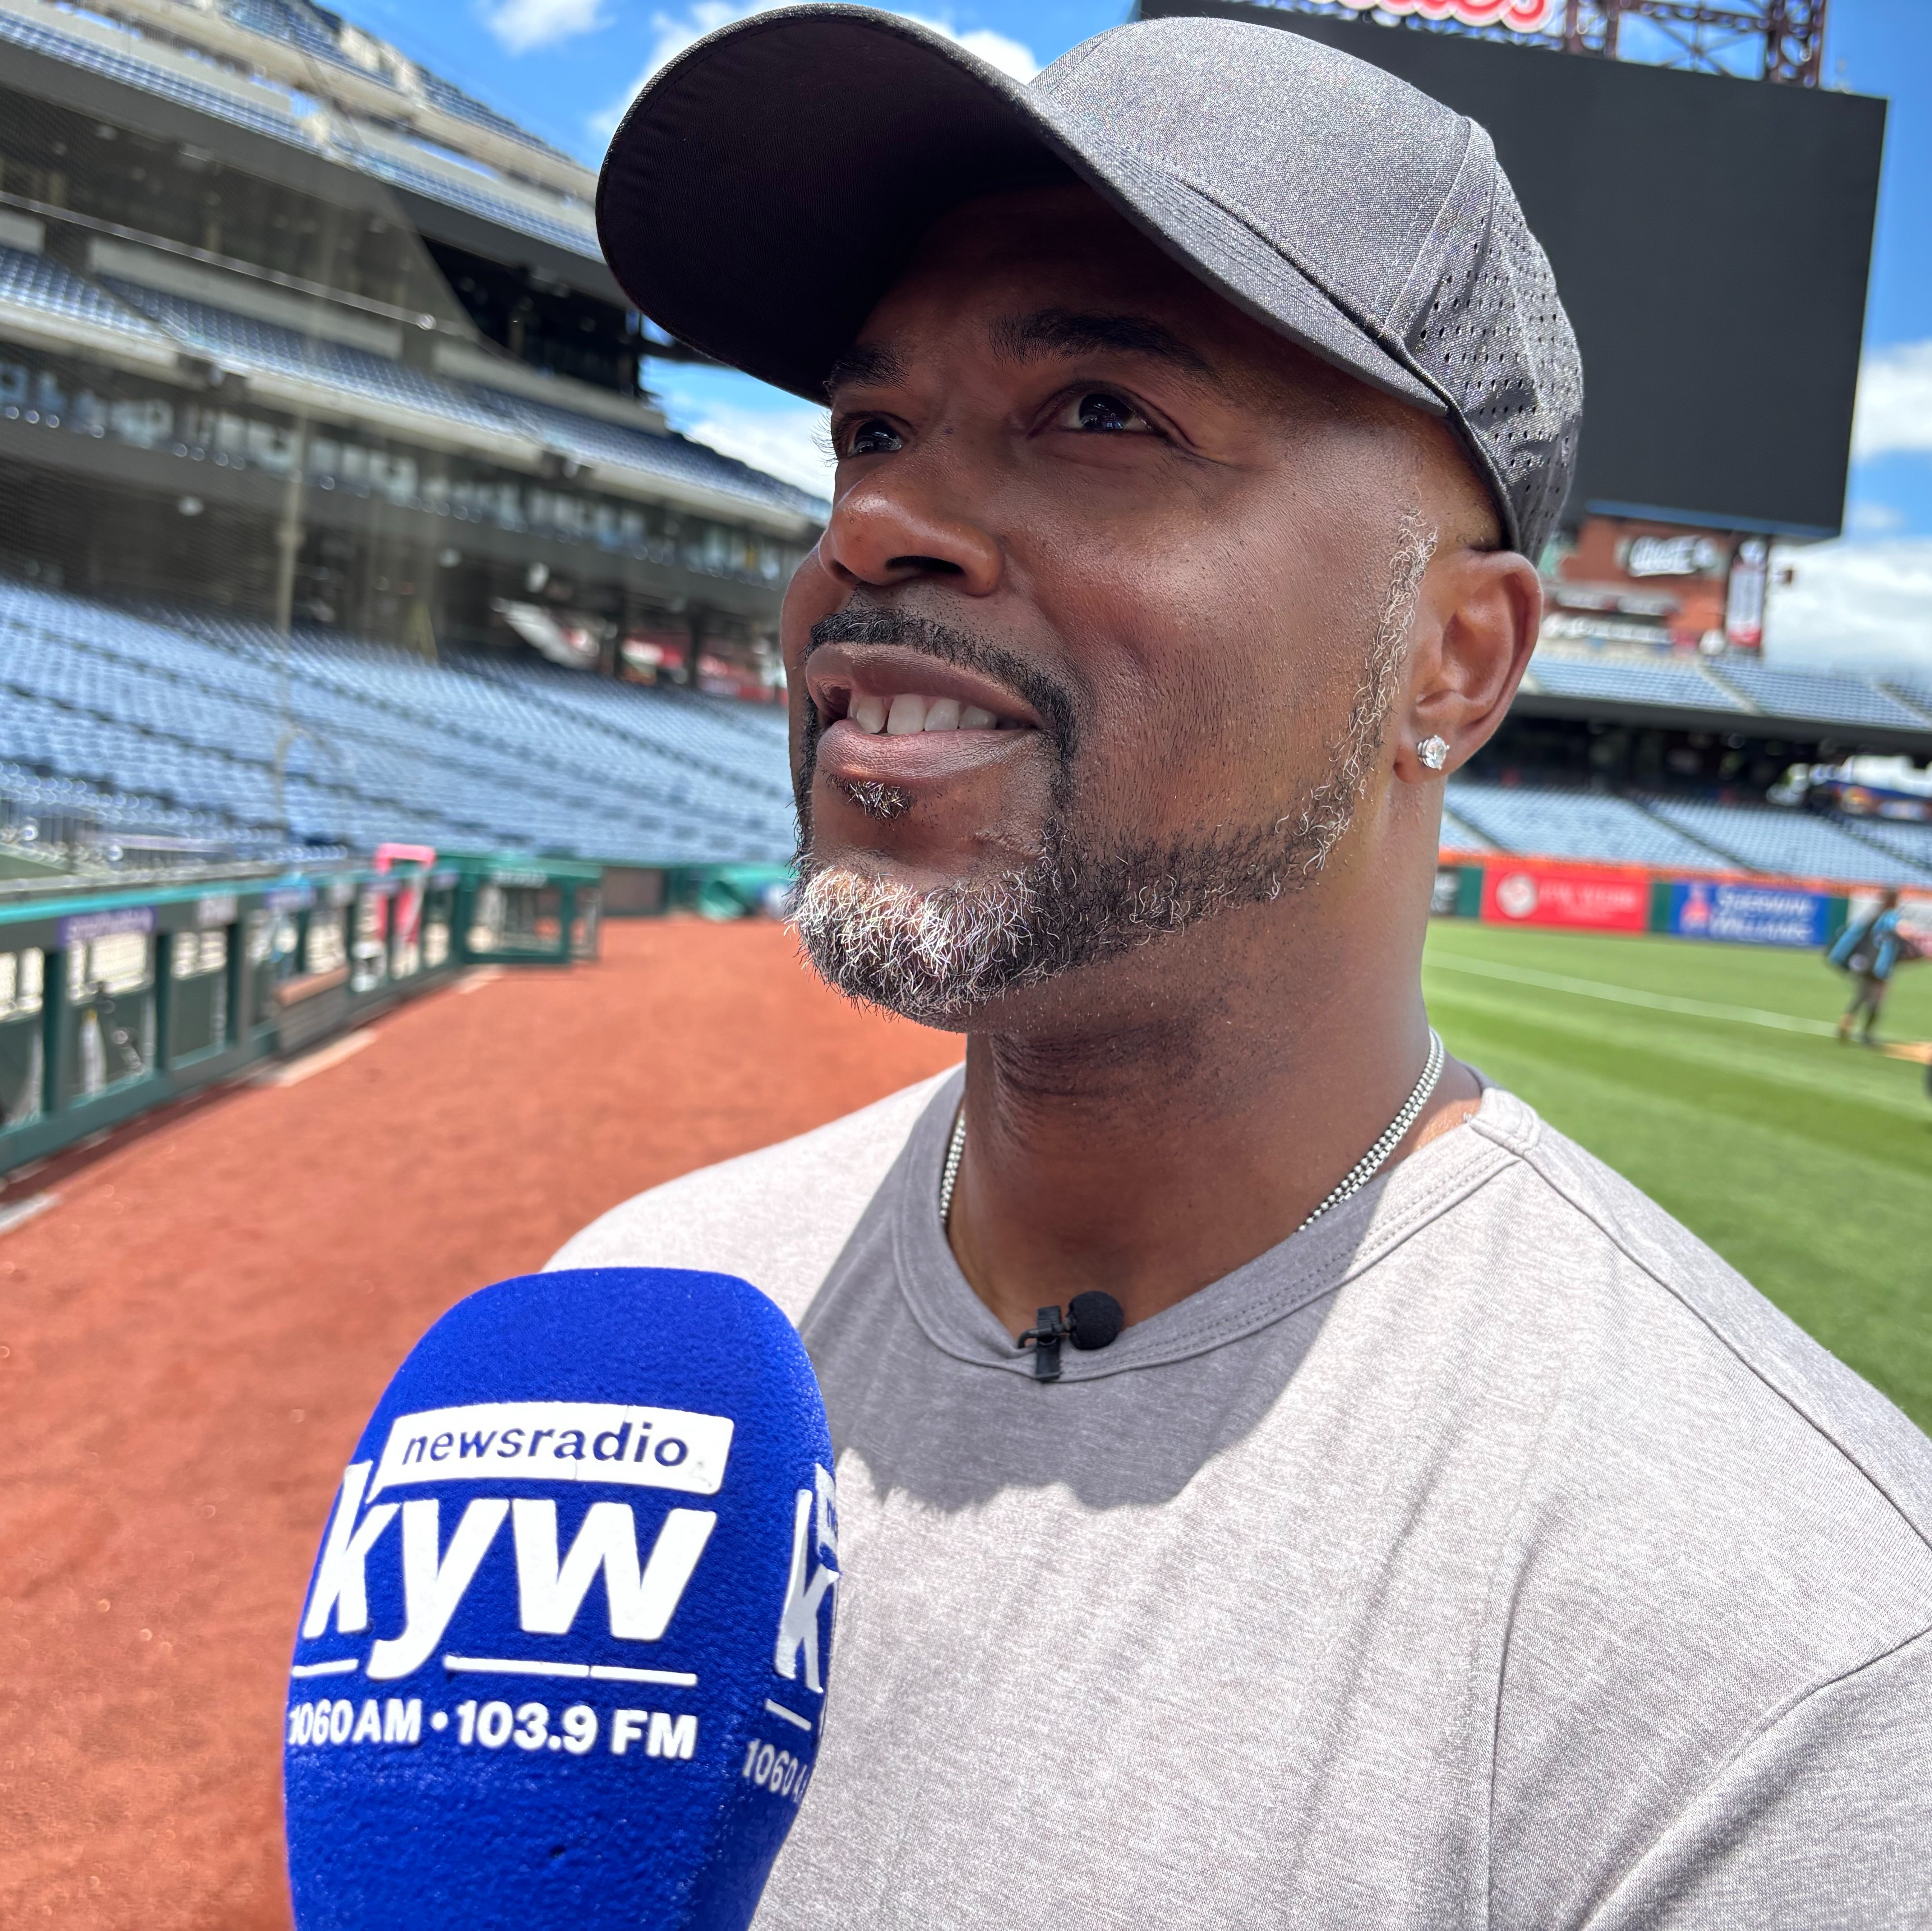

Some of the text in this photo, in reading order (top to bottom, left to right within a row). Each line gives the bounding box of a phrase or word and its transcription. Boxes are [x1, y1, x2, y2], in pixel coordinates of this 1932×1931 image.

[402, 1421, 689, 1467] newsradio
[302, 1460, 717, 1679] kyw
[457, 1700, 598, 1754] 103.9
[612, 1709, 698, 1759] FM
